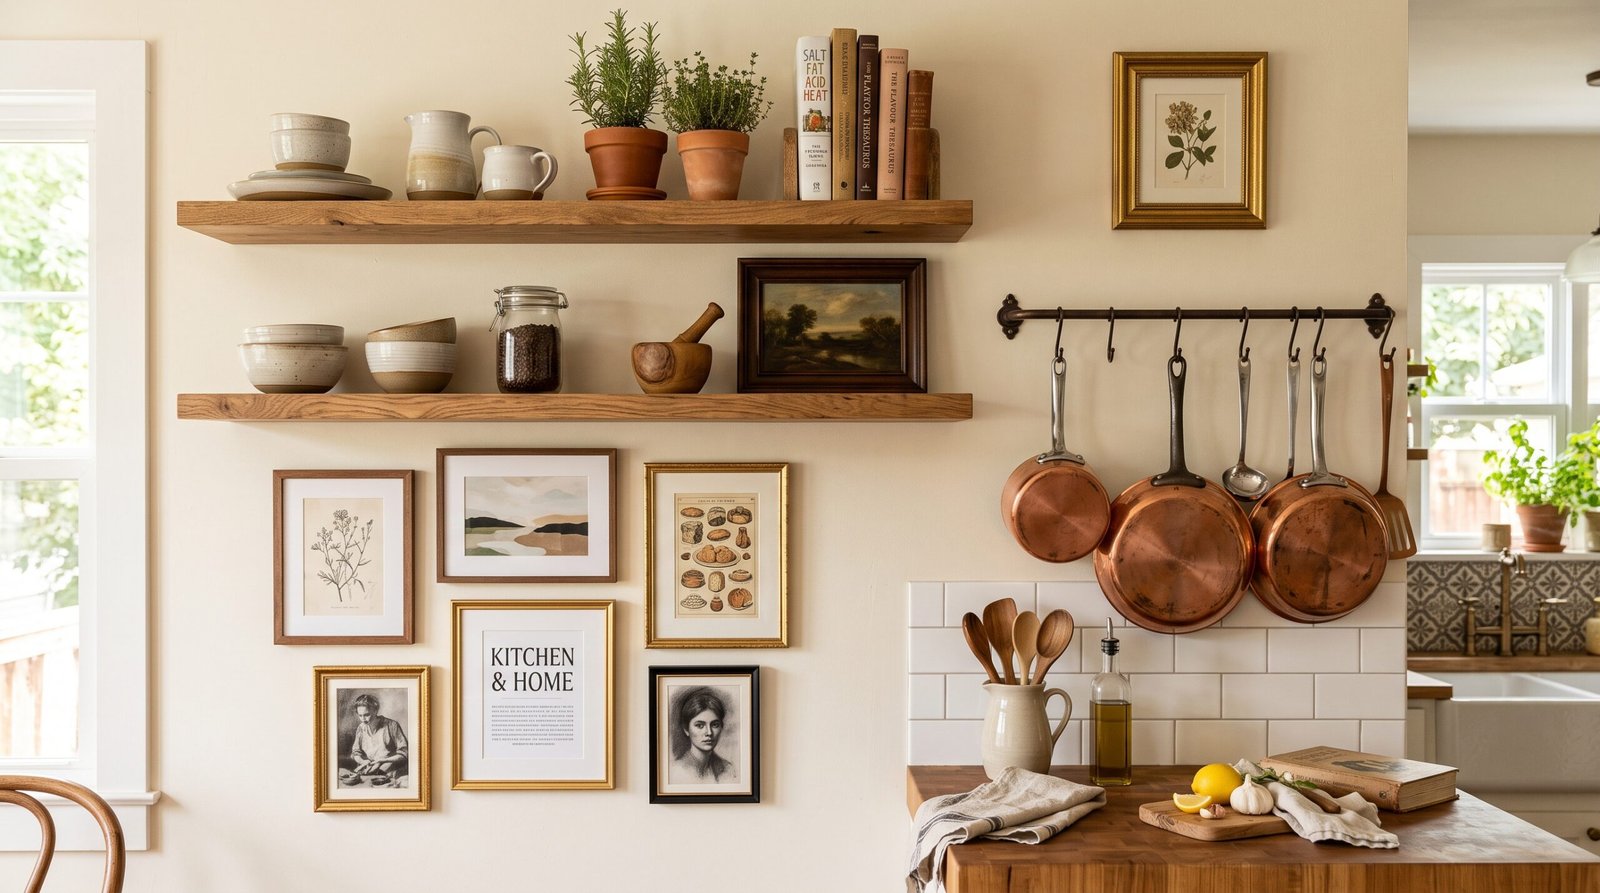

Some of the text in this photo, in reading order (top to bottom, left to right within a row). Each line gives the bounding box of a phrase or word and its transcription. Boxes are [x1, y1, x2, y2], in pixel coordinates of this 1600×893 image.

[803, 49, 827, 62] SALT
[806, 62, 824, 75] FAT
[805, 75, 826, 88] ACID
[803, 89, 828, 102] HEAT
[889, 89, 897, 124] FLAVOUR
[888, 127, 896, 174] THESAURUS
[491, 647, 574, 666] KITCHEN
[492, 671, 574, 692] & HOME
